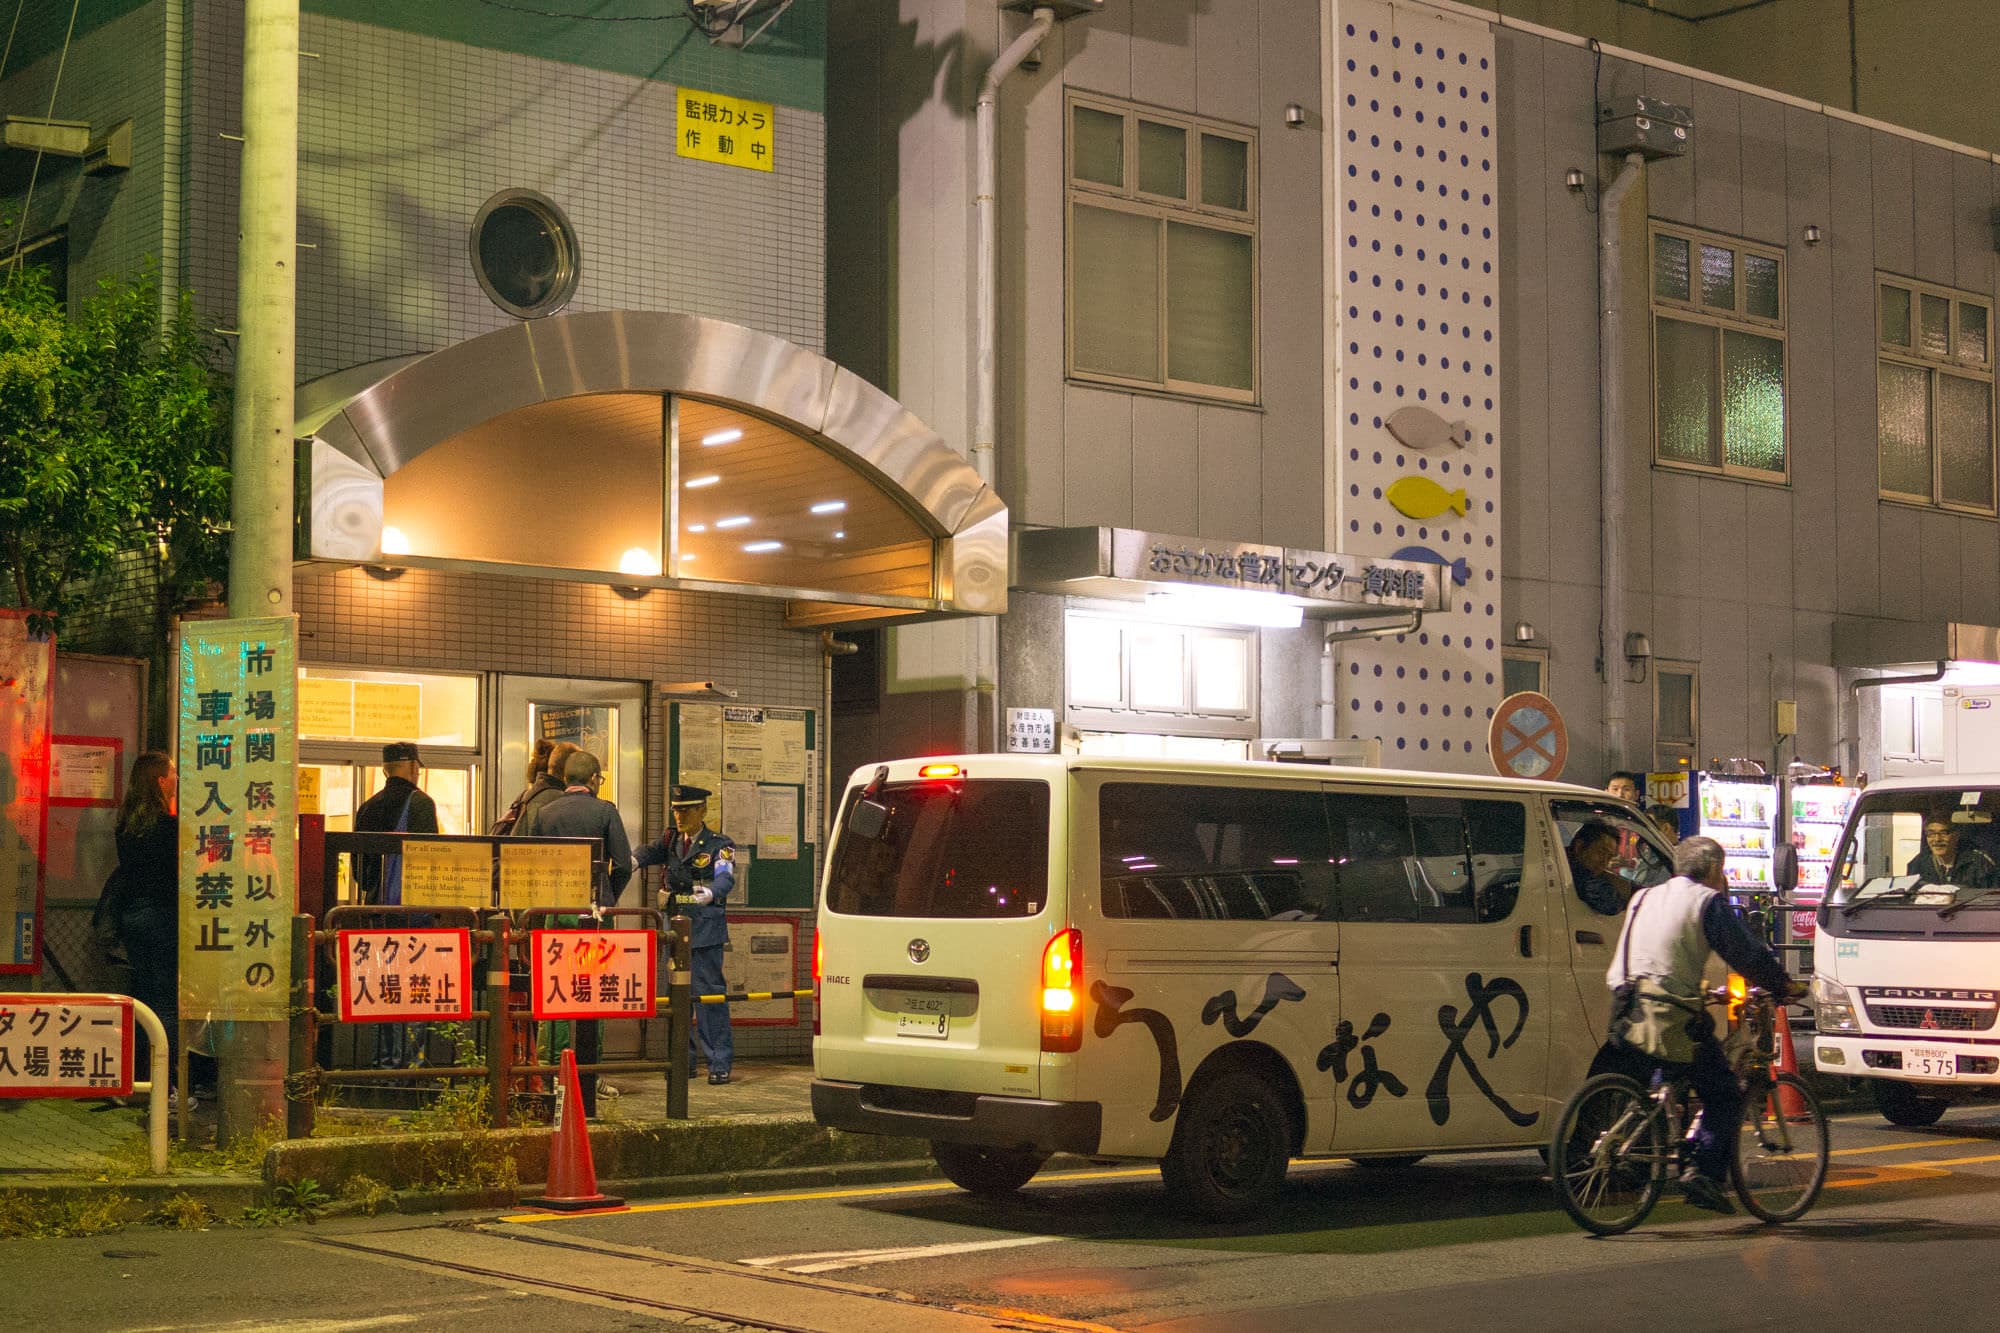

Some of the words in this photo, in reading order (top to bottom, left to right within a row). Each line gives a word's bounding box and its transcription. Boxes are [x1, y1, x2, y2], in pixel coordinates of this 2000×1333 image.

[686, 99, 766, 130] 監視カメラ
[686, 128, 766, 160] 作動中
[1151, 542, 1425, 599] おさかな普及センター資料館
[194, 689, 234, 952] 車両入場禁止
[245, 646, 276, 989] 市場関係者以外の
[353, 936, 454, 964] タクシー
[547, 938, 641, 964] タクシー
[353, 973, 456, 1005] 入場禁止
[546, 973, 643, 1003] 入場禁止
[826, 975, 851, 985] HIACE
[1864, 989, 1993, 999] CANTER
[0, 1008, 113, 1037] タクシー
[938, 1014, 946, 1034] 8
[0, 1046, 115, 1078] 入場禁止
